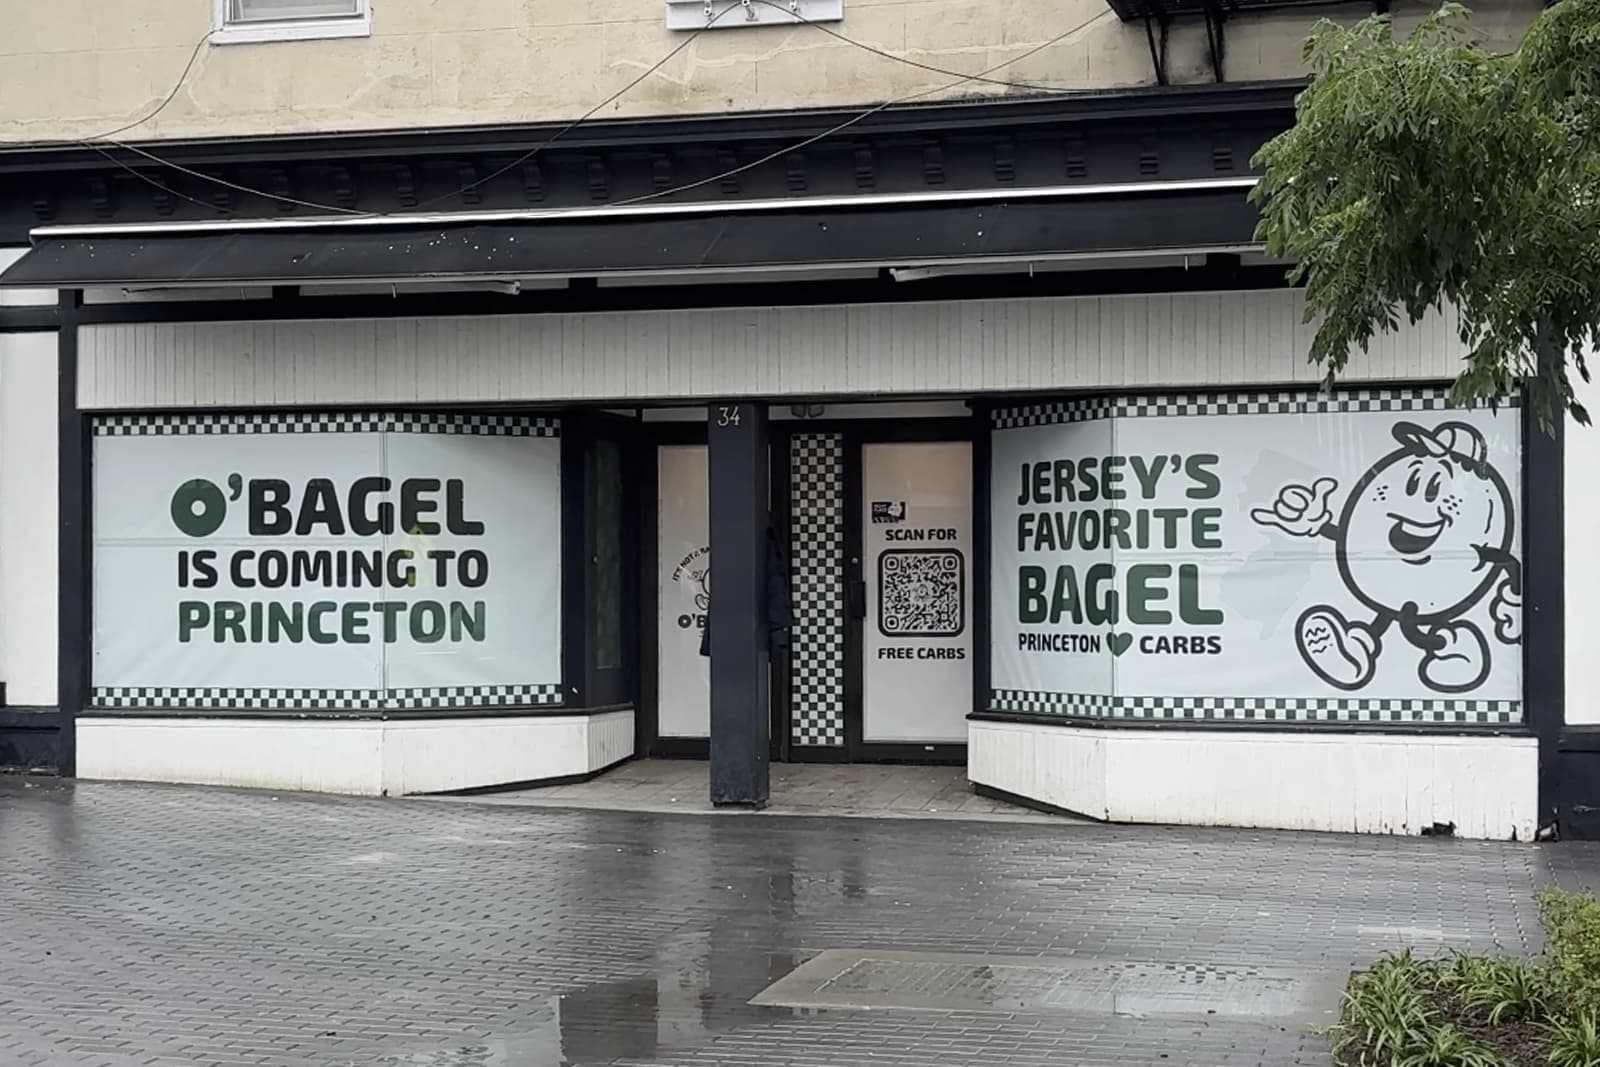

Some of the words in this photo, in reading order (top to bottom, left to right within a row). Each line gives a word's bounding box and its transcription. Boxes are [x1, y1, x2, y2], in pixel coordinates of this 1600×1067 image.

[717, 407, 740, 426] 34
[1017, 453, 1222, 505] JERSEY'S
[171, 473, 484, 537] O'BAGEL
[885, 529, 925, 541] SCAN
[927, 528, 957, 541] FOR
[1017, 508, 1222, 553] FAVORITE
[179, 550, 218, 588] IS
[231, 550, 416, 588] COMING
[427, 550, 489, 588] TO
[680, 553, 694, 568] NOT
[1018, 564, 1223, 625] BAGEL
[180, 601, 486, 643] PRINCETON
[879, 648, 914, 660] FREE
[917, 648, 966, 660] CARBS
[1018, 633, 1101, 653] PRINCETON
[1140, 636, 1222, 655] CARBS
